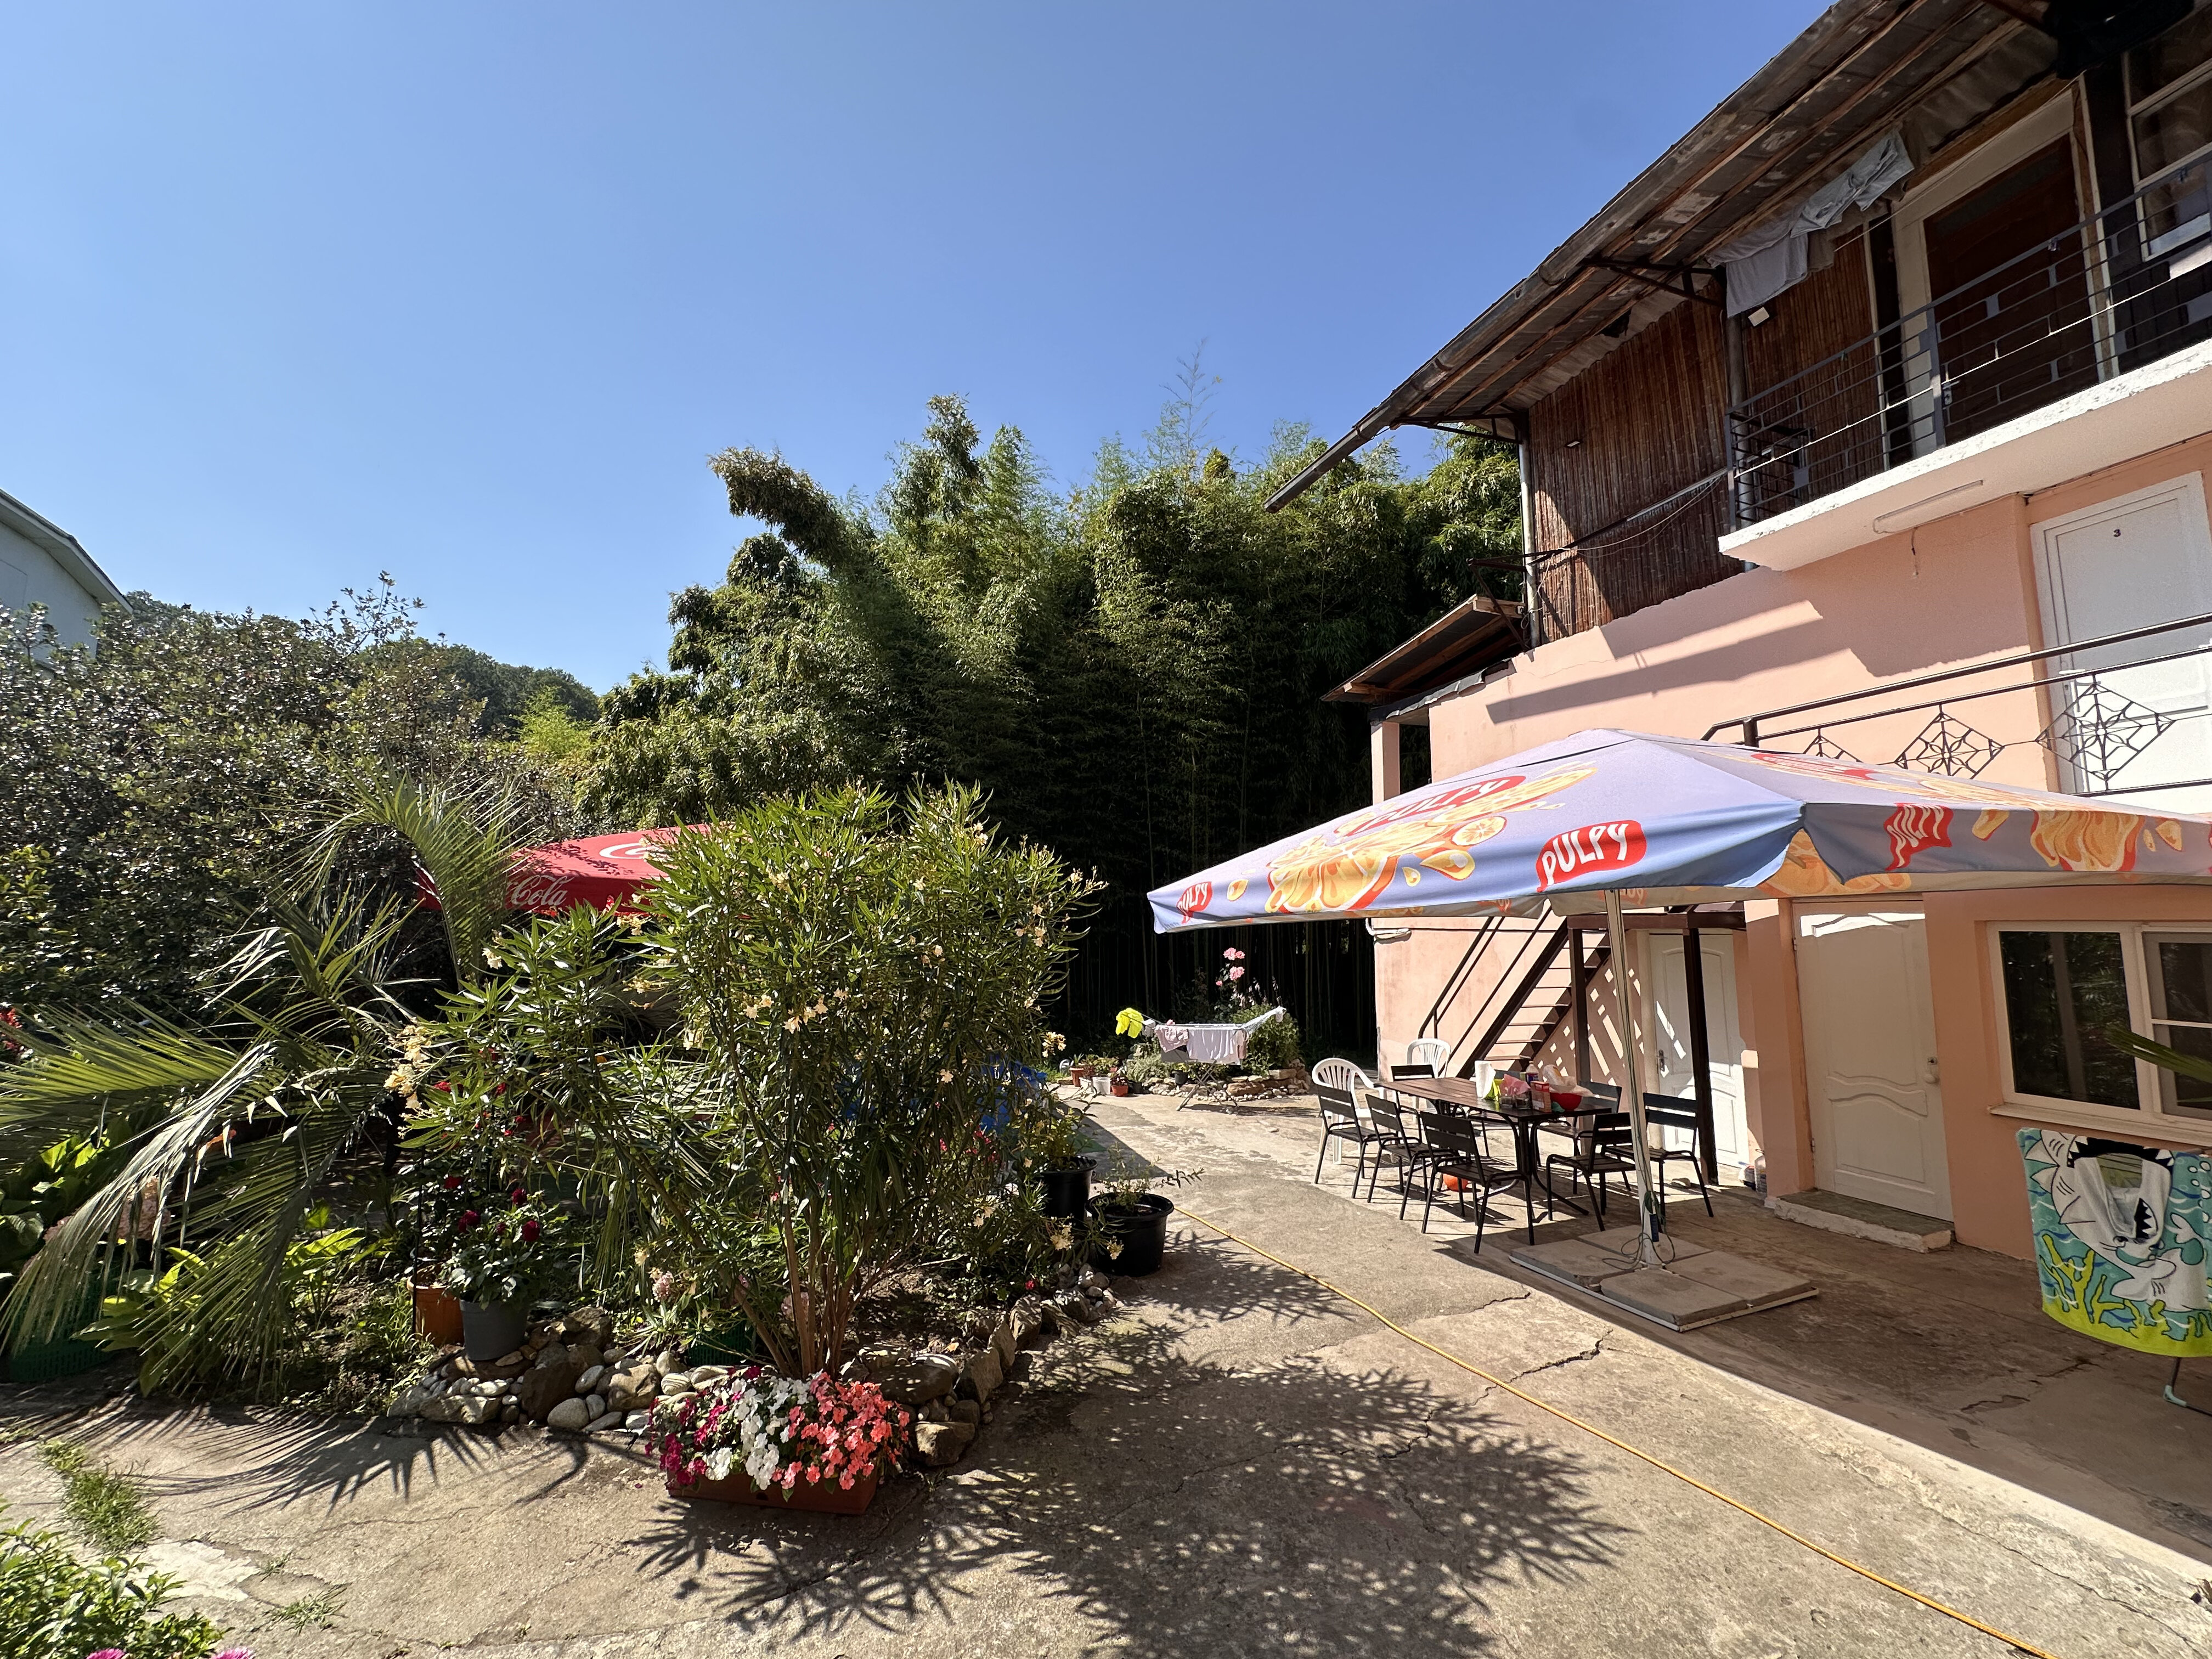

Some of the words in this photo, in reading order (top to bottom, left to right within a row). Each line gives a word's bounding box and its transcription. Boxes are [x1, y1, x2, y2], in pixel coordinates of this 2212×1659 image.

[2113, 529, 2121, 537] 3
[1352, 780, 1510, 834] PULPY
[1542, 823, 1629, 885] PULPY
[1886, 804, 1945, 868] PULPY
[1177, 882, 1209, 922] PULPY
